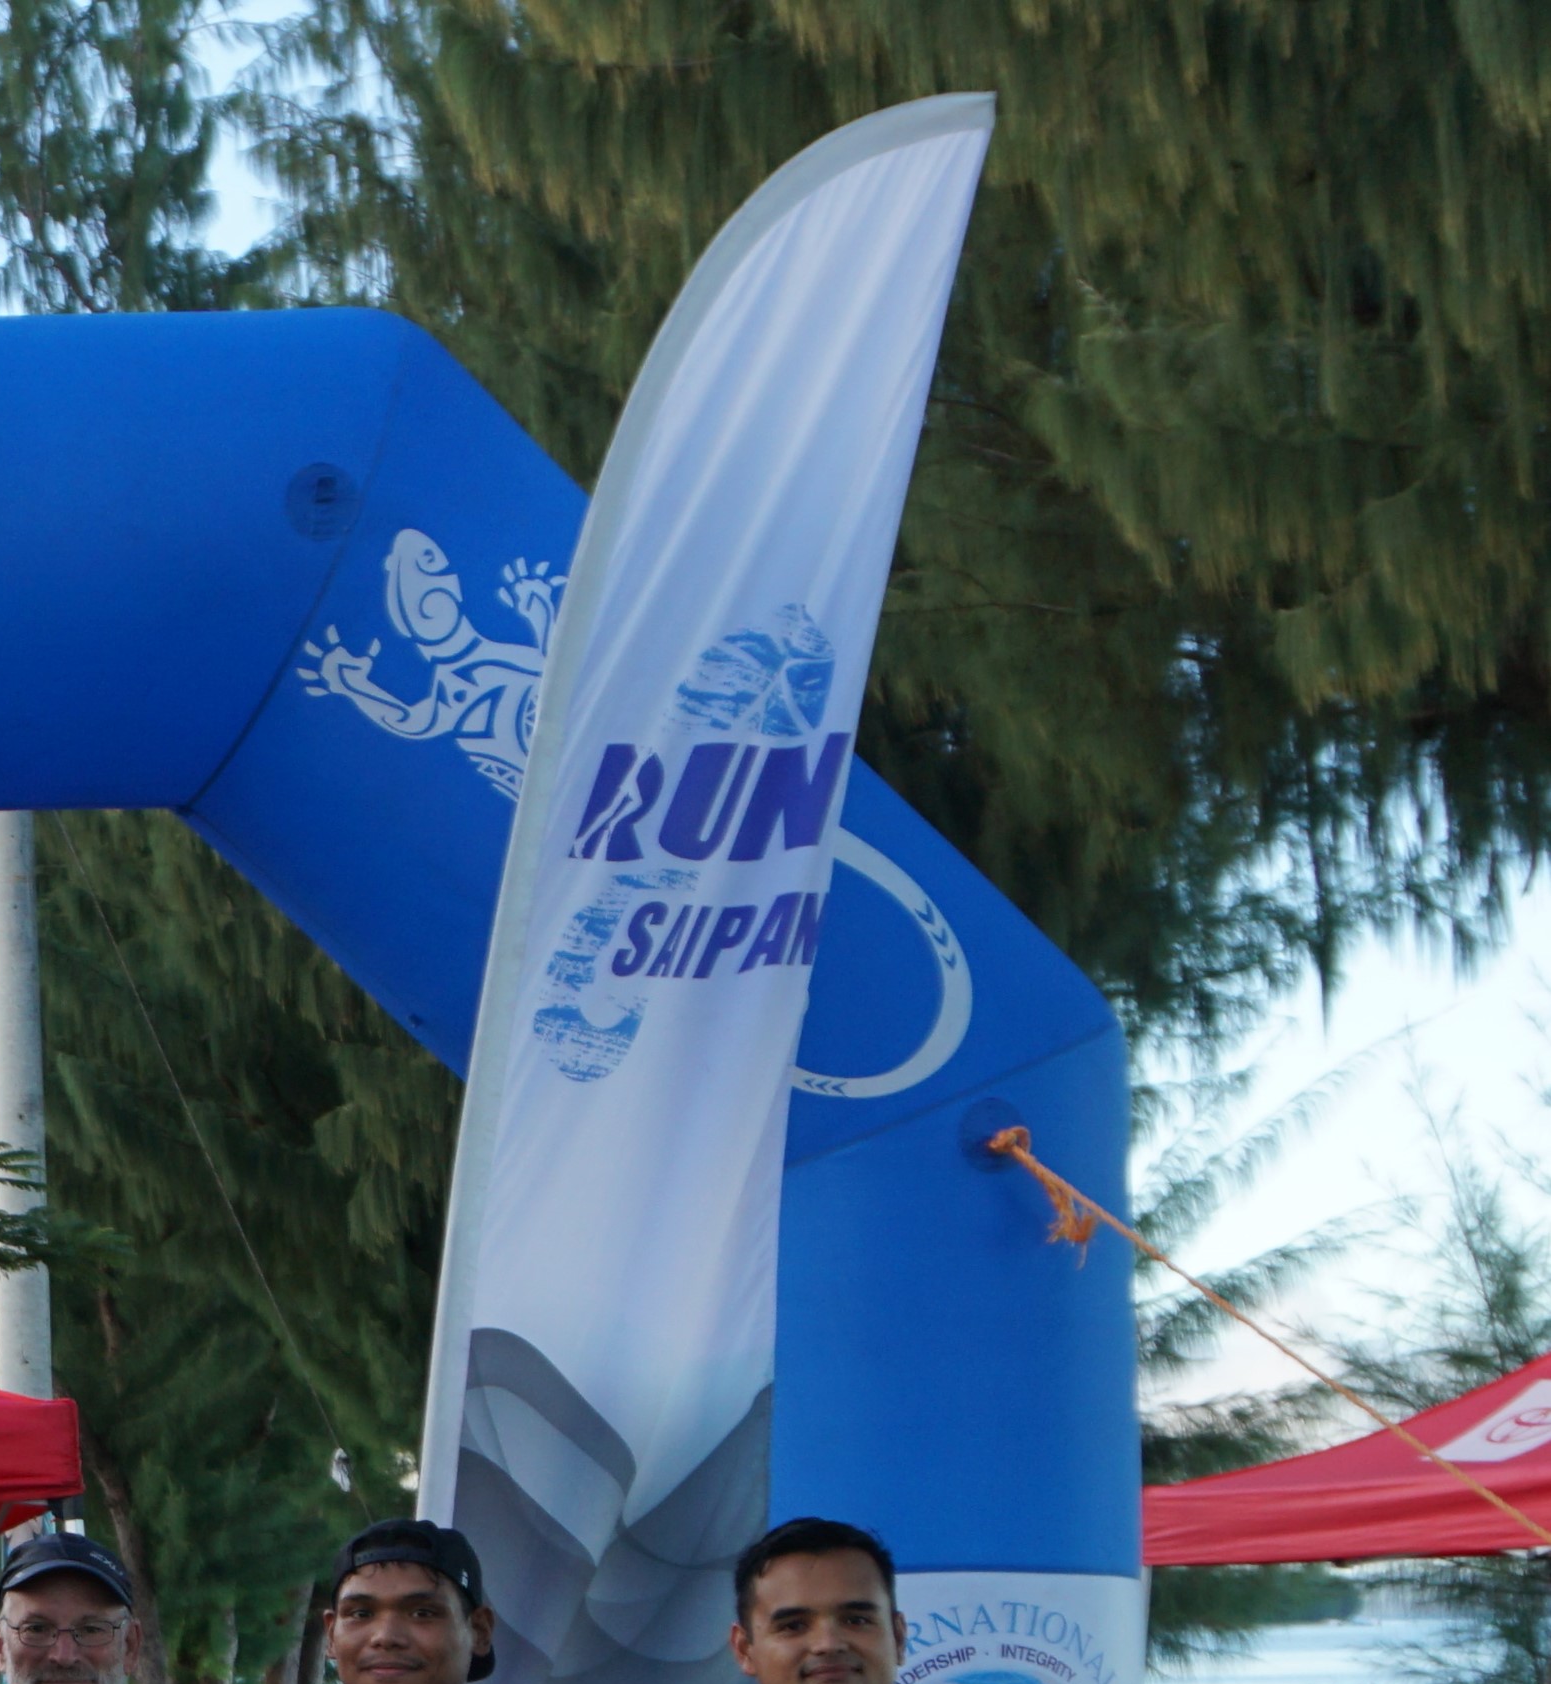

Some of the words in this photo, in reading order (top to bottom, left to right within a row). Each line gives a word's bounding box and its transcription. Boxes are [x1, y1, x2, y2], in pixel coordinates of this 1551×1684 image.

[568, 732, 852, 862] RUN
[610, 890, 830, 980] SAIPAN
[1000, 1643, 1078, 1684] INTEGRITY
